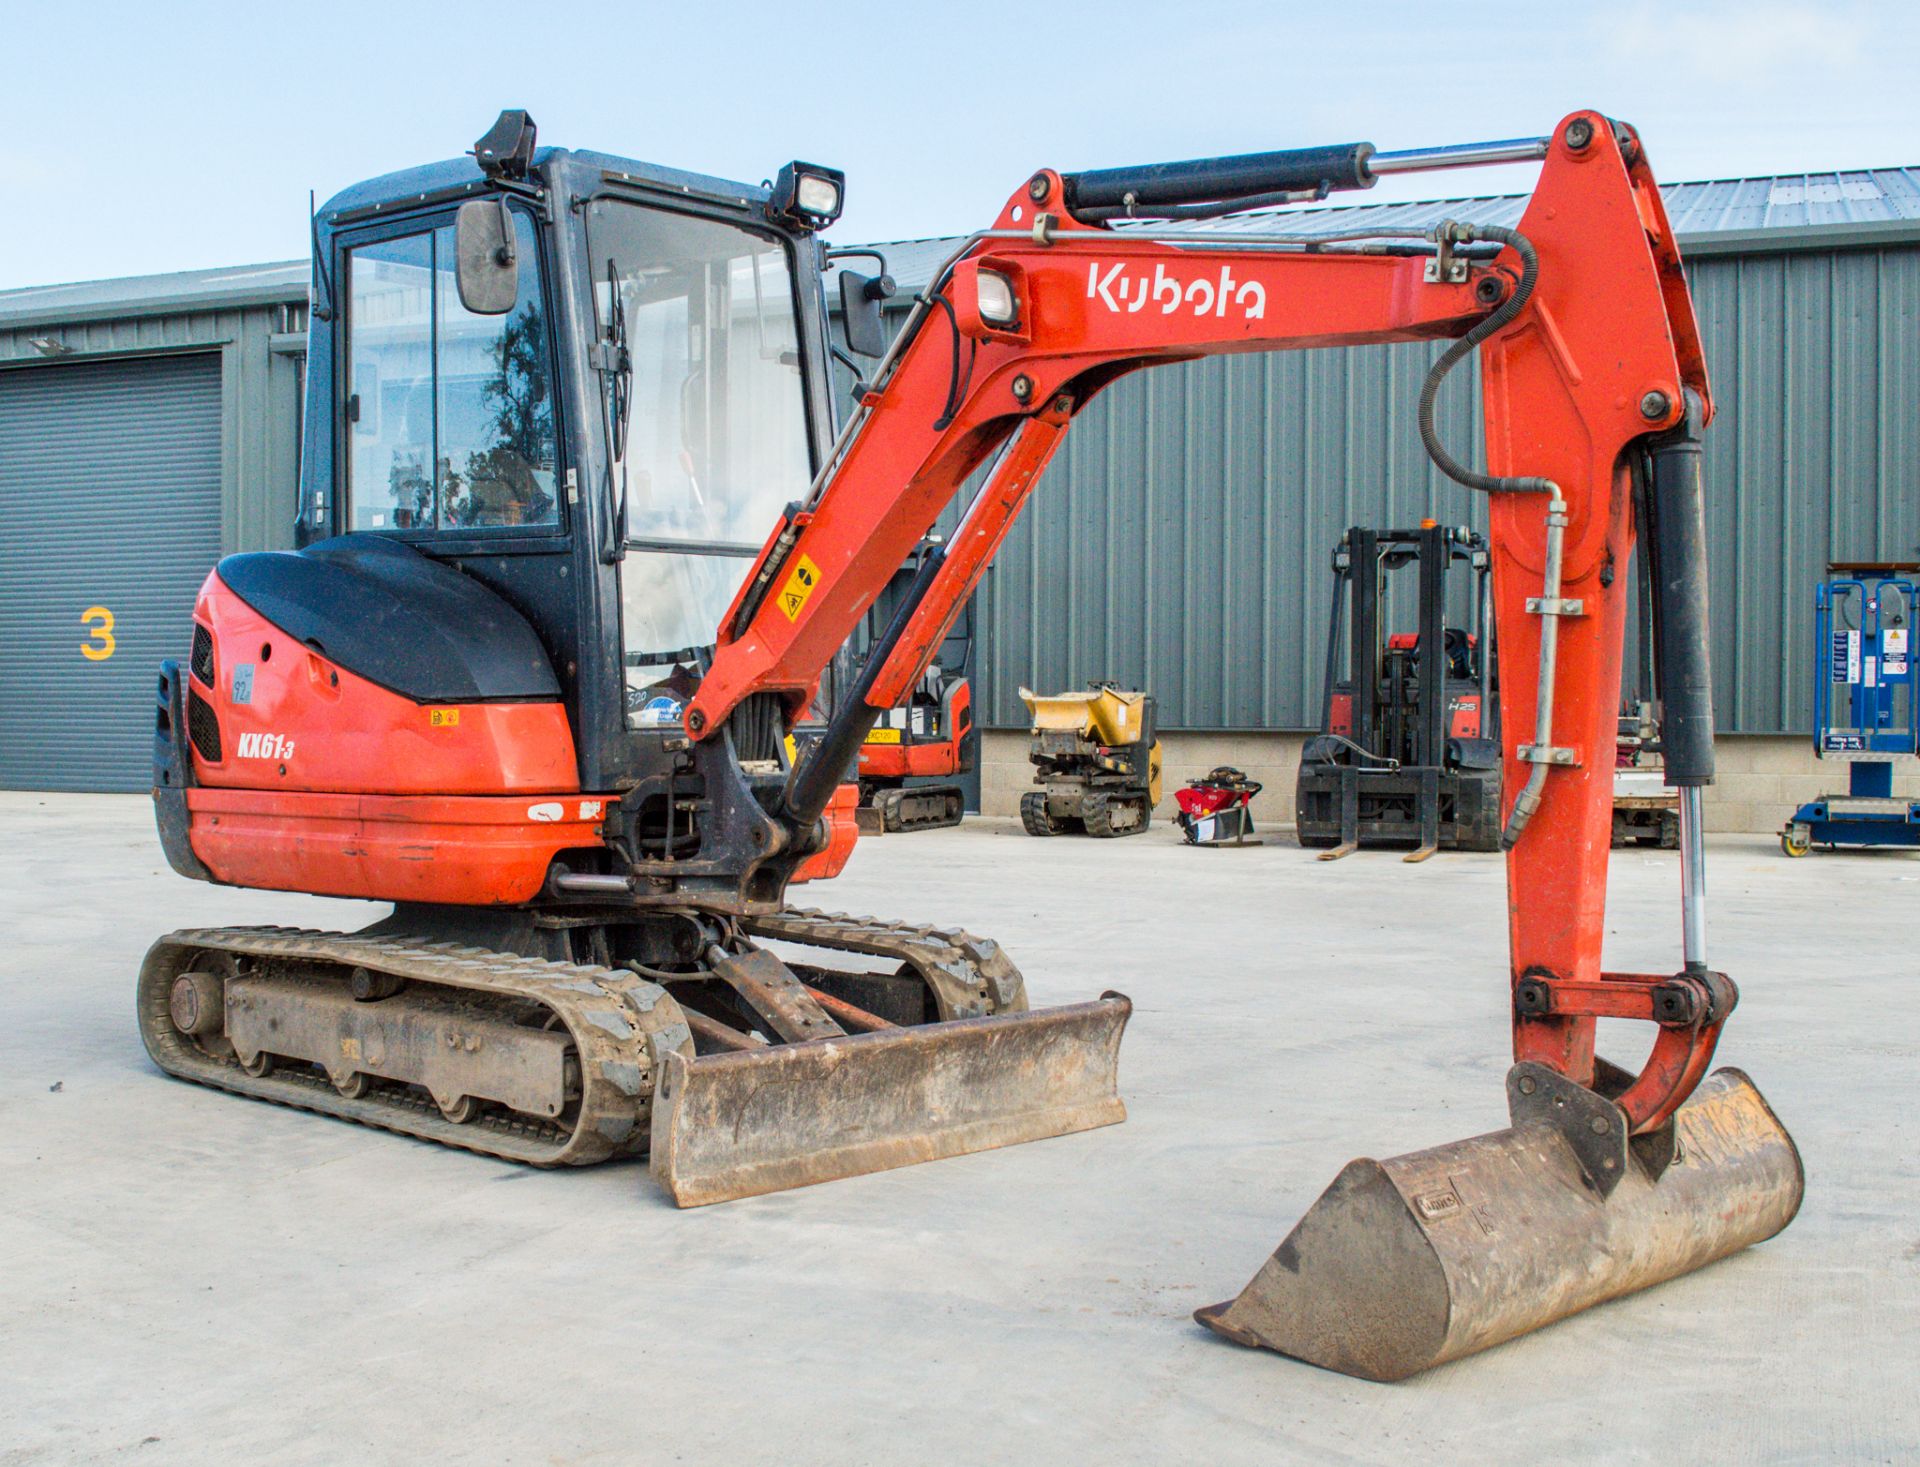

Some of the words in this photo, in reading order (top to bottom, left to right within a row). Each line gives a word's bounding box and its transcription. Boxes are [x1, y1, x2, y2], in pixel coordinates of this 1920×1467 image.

[1087, 262, 1267, 319] Kubota
[80, 606, 116, 661] 3
[237, 732, 295, 760] KX61-3
